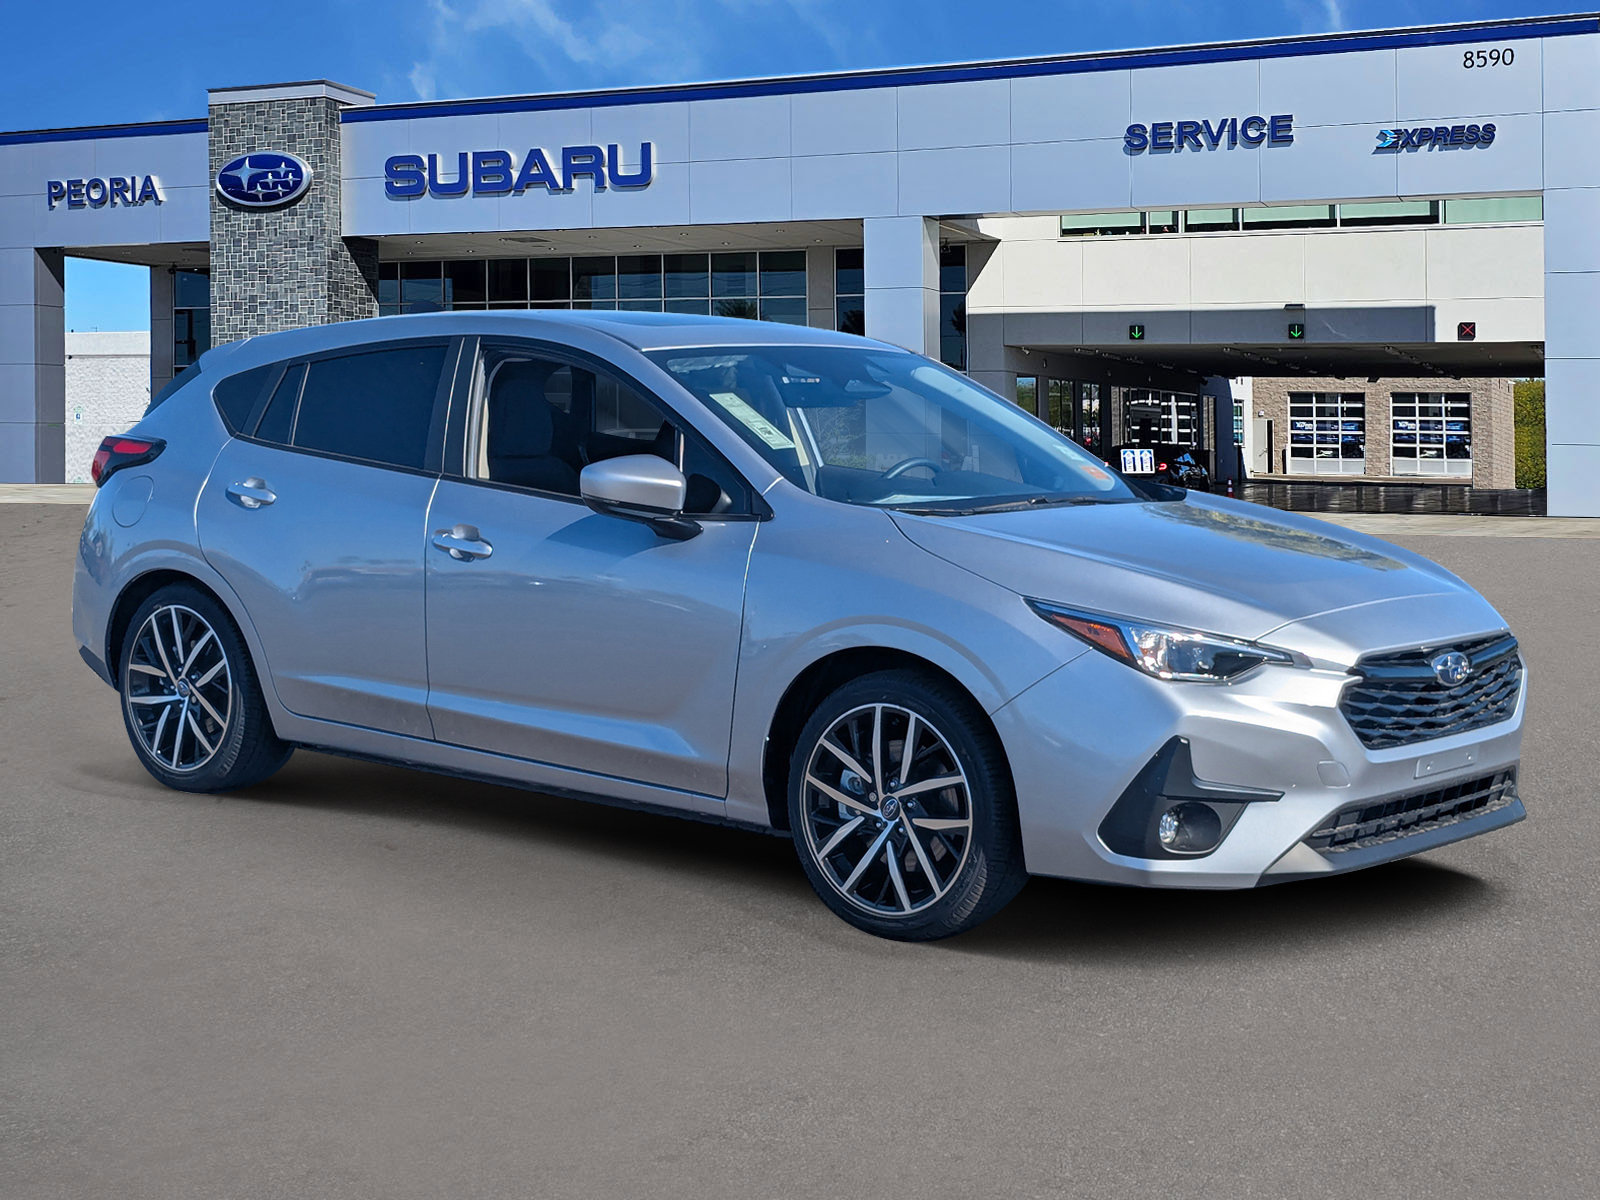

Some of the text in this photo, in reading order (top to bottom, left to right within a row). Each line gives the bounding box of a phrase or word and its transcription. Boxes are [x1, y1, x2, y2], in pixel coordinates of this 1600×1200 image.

[1463, 48, 1515, 69] 8590
[1124, 114, 1294, 153] SERVICE
[1375, 123, 1497, 151] EXPRESS
[384, 142, 652, 199] SUBARU
[47, 175, 163, 209] PEORIA
